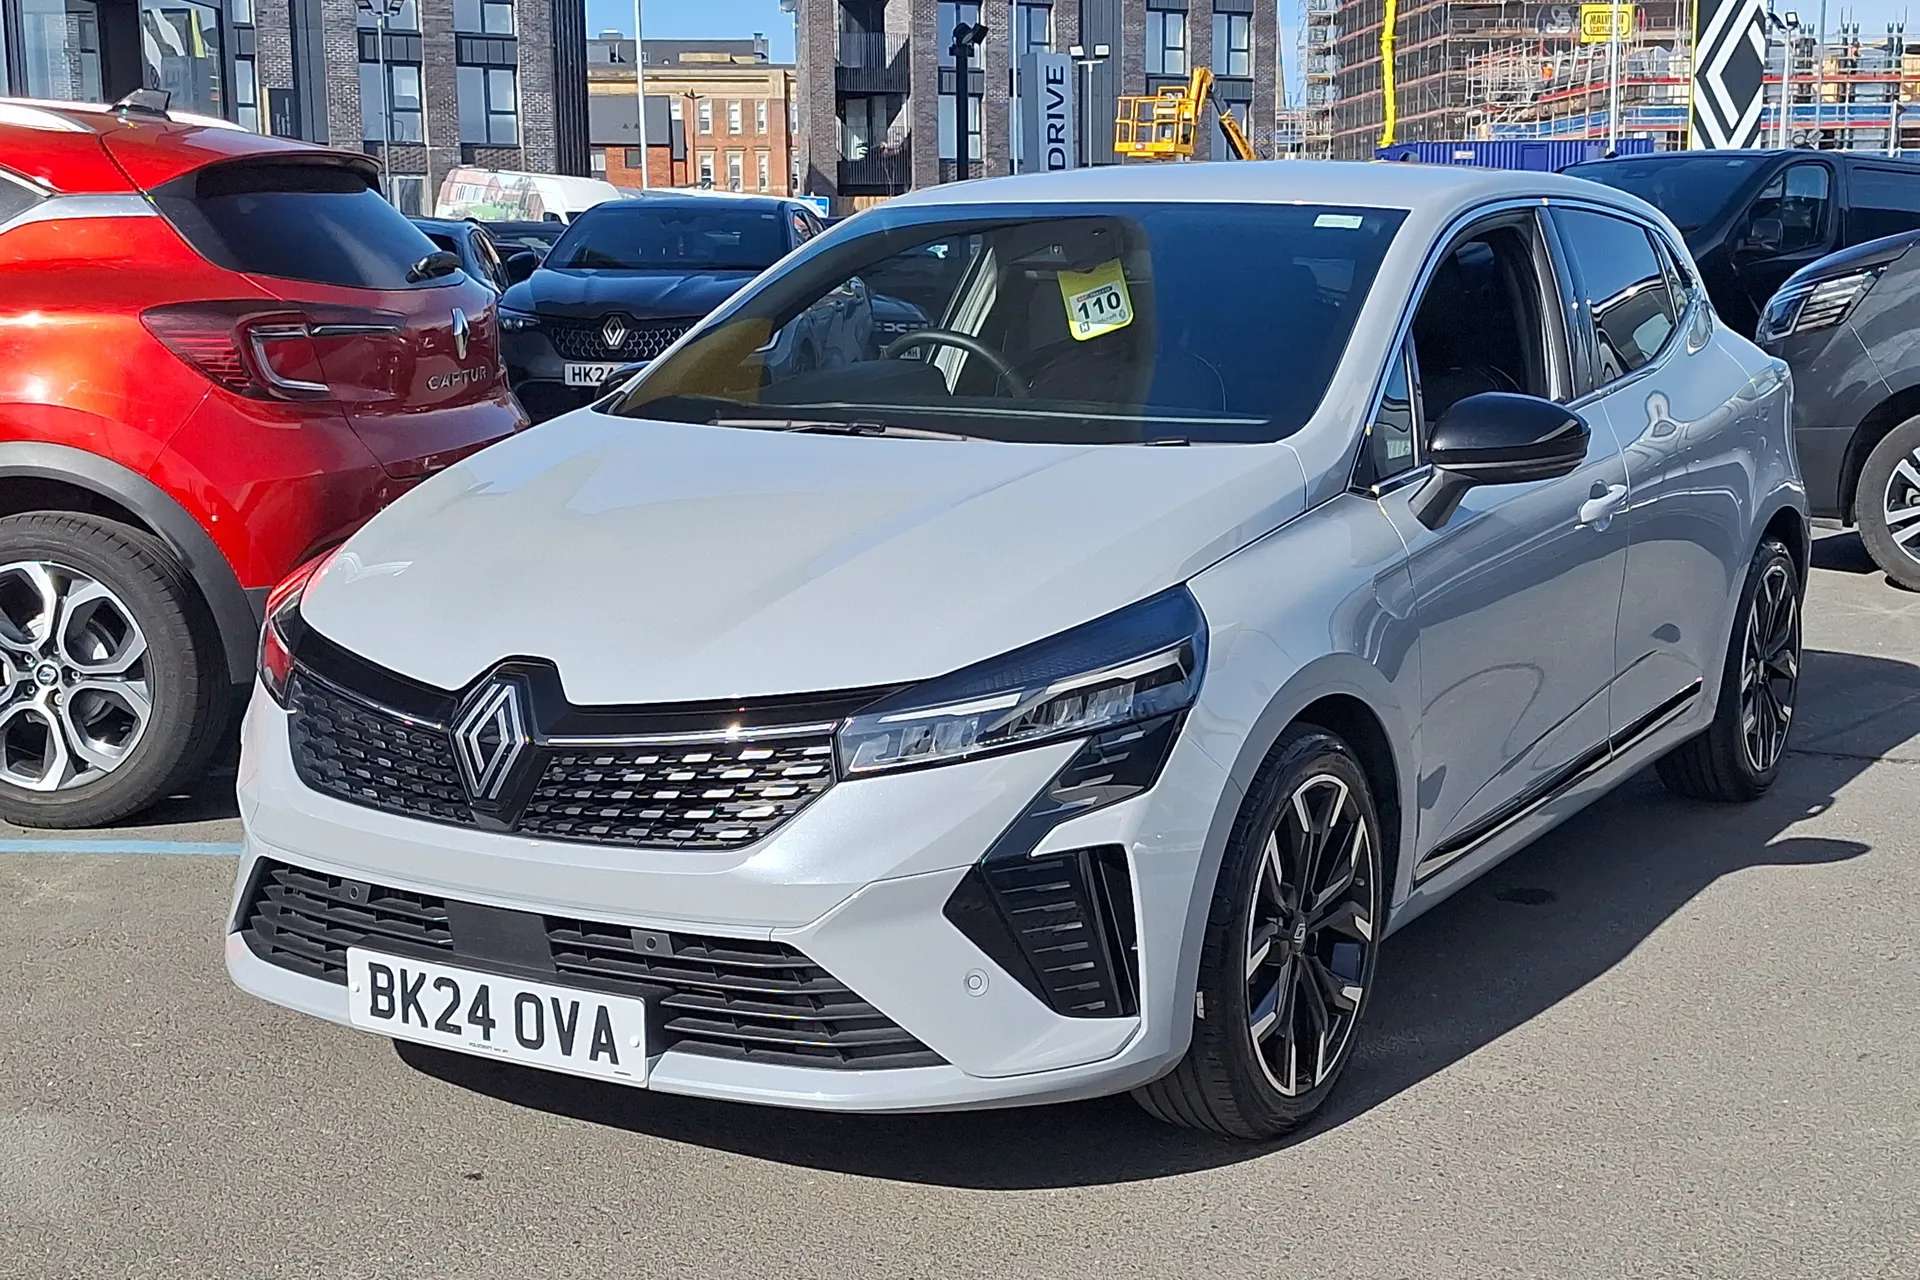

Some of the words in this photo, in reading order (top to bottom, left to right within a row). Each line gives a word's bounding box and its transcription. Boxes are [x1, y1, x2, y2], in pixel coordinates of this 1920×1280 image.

[1046, 65, 1066, 171] DRIVE
[1078, 292, 1121, 320] 110
[427, 366, 487, 391] CAPTUR
[368, 962, 496, 1041] BK24
[514, 991, 619, 1065] OVA
